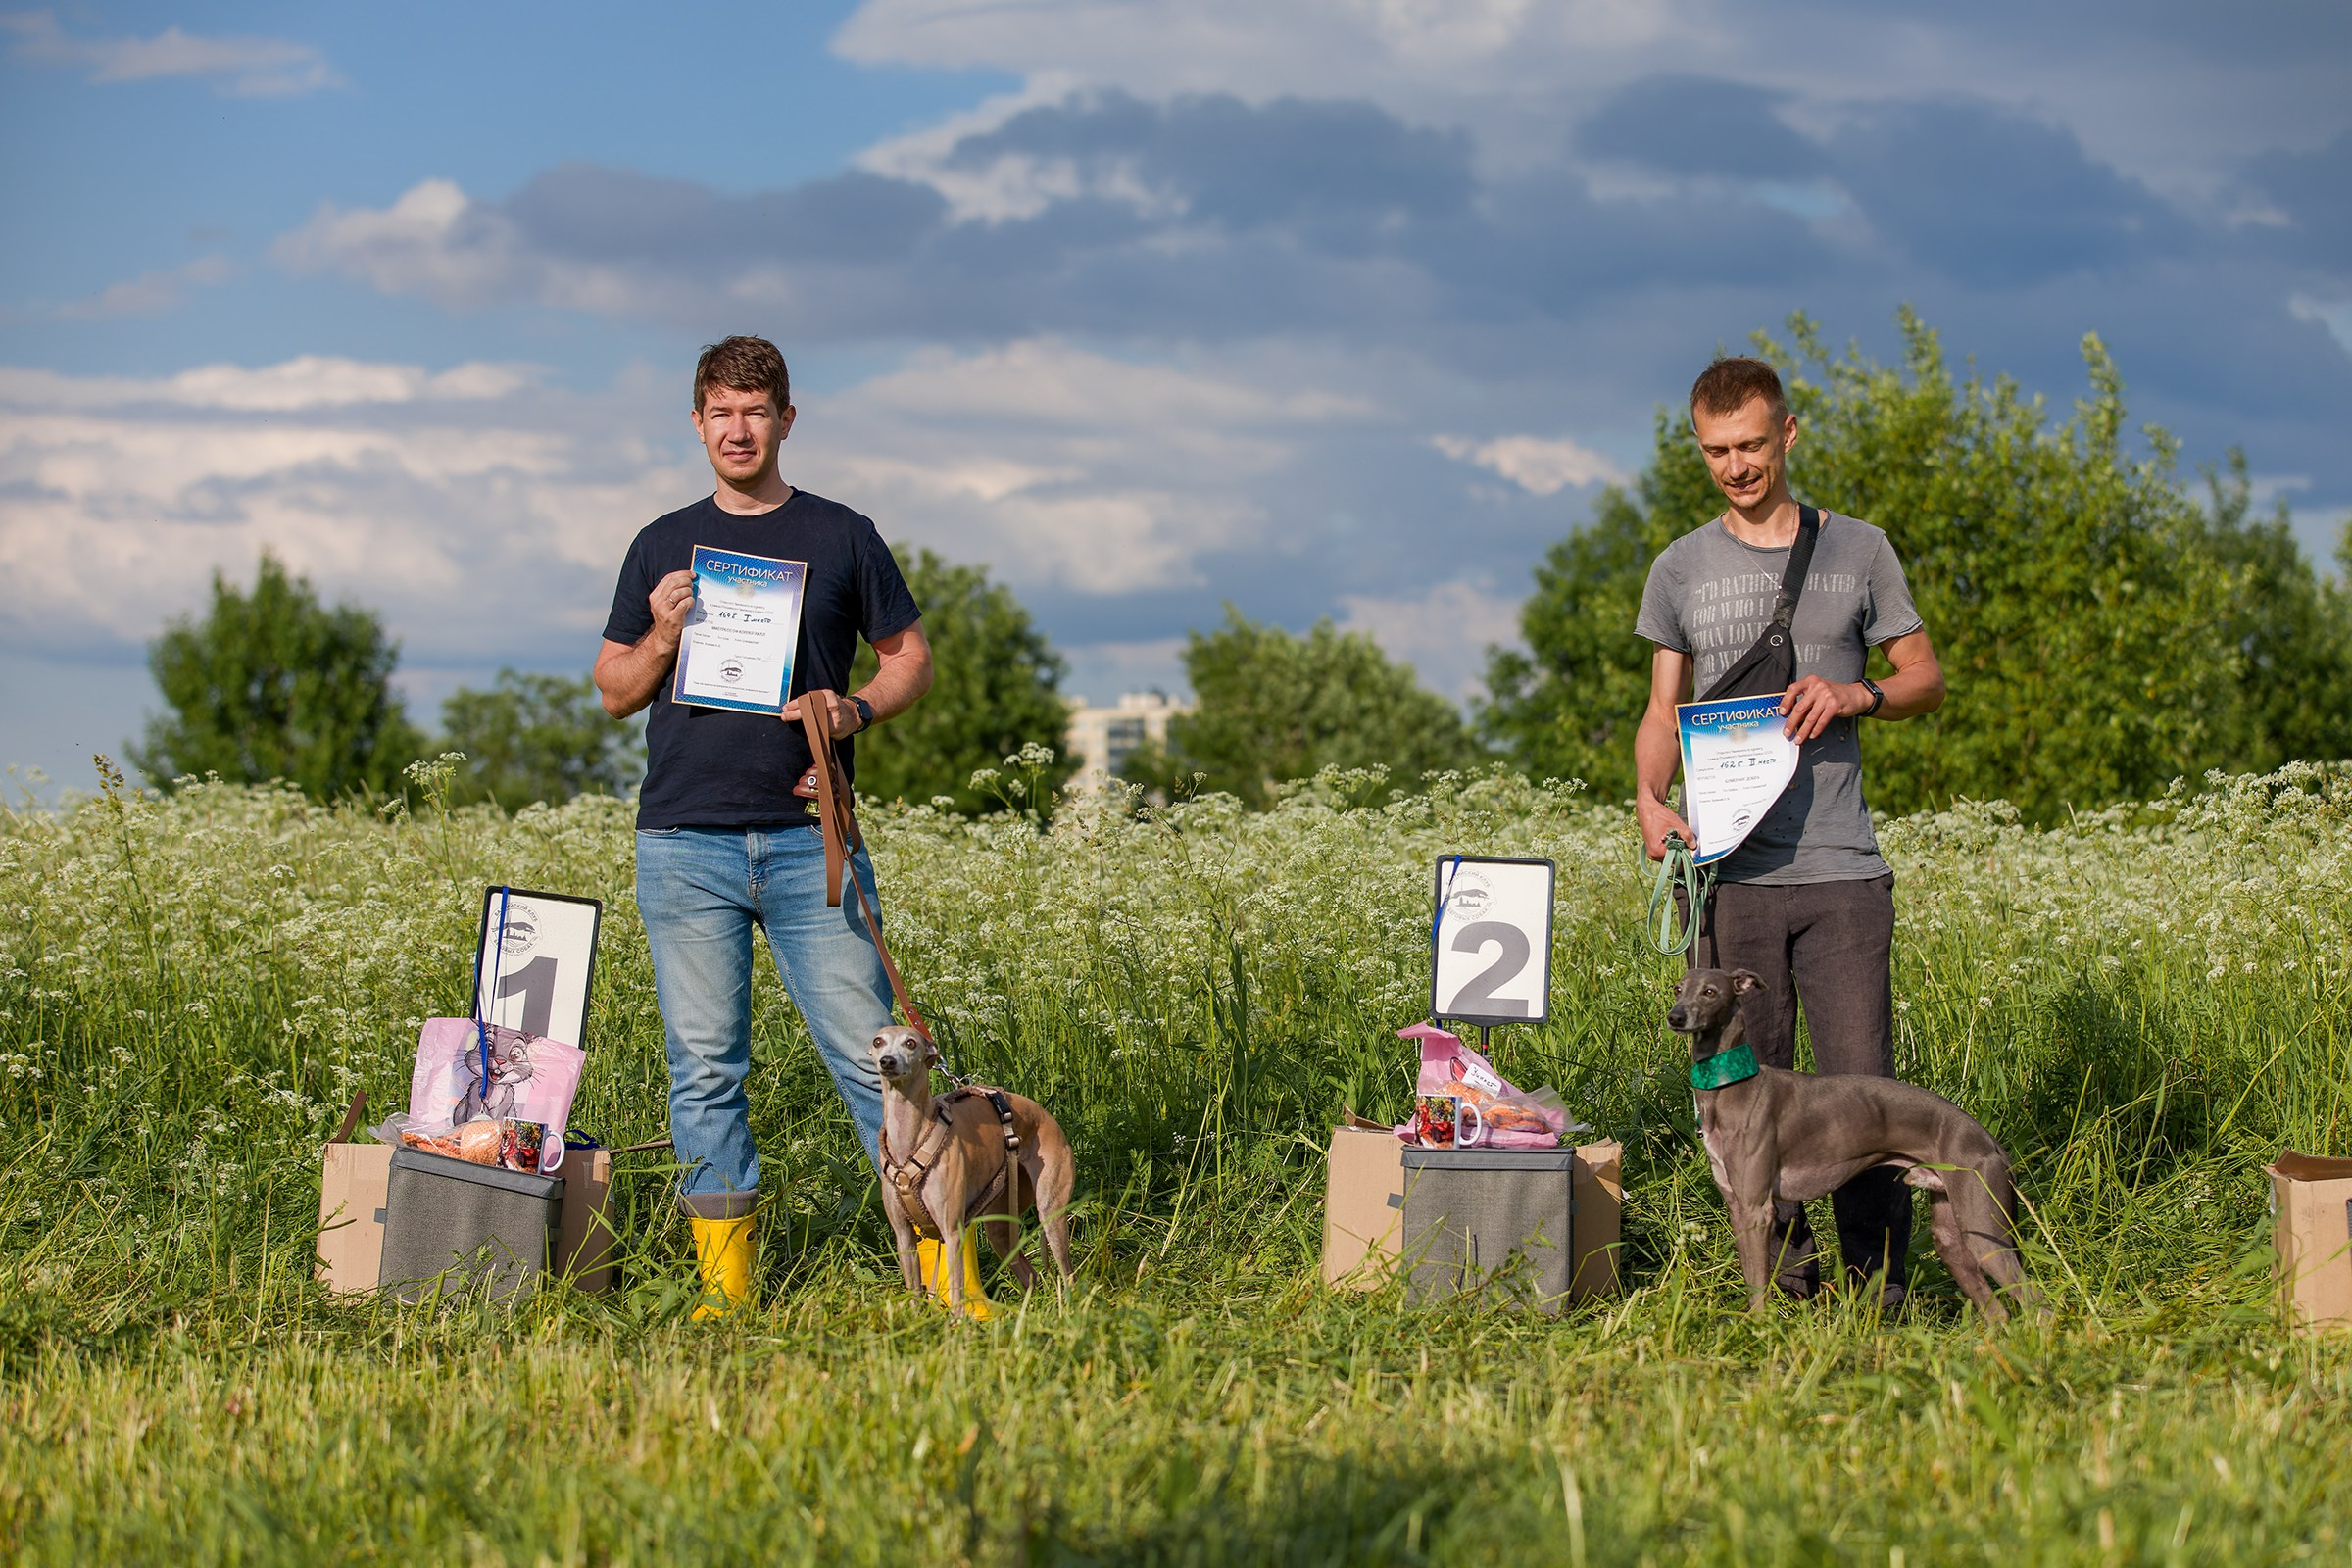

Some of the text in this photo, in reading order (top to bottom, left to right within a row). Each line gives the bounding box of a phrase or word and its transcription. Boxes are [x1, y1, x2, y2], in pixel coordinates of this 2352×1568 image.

[706, 560, 793, 582] СЕРТИФИКАТ
[727, 575, 767, 588] участника
[1722, 572, 1779, 597] RATHER
[1808, 573, 1856, 592] HATED
[1693, 605, 1716, 628] FOR
[1720, 599, 1754, 620] WHO
[1759, 598, 1764, 616] I
[1692, 621, 1772, 652] THAN LOVE
[1691, 706, 1781, 726] СЕРТИФИКАТ
[1717, 720, 1759, 732] участника
[528, 909, 538, 922] КЛУБ
[516, 942, 533, 954] СОБАК
[1447, 921, 1530, 1017] 2
[497, 956, 558, 1038] 1
